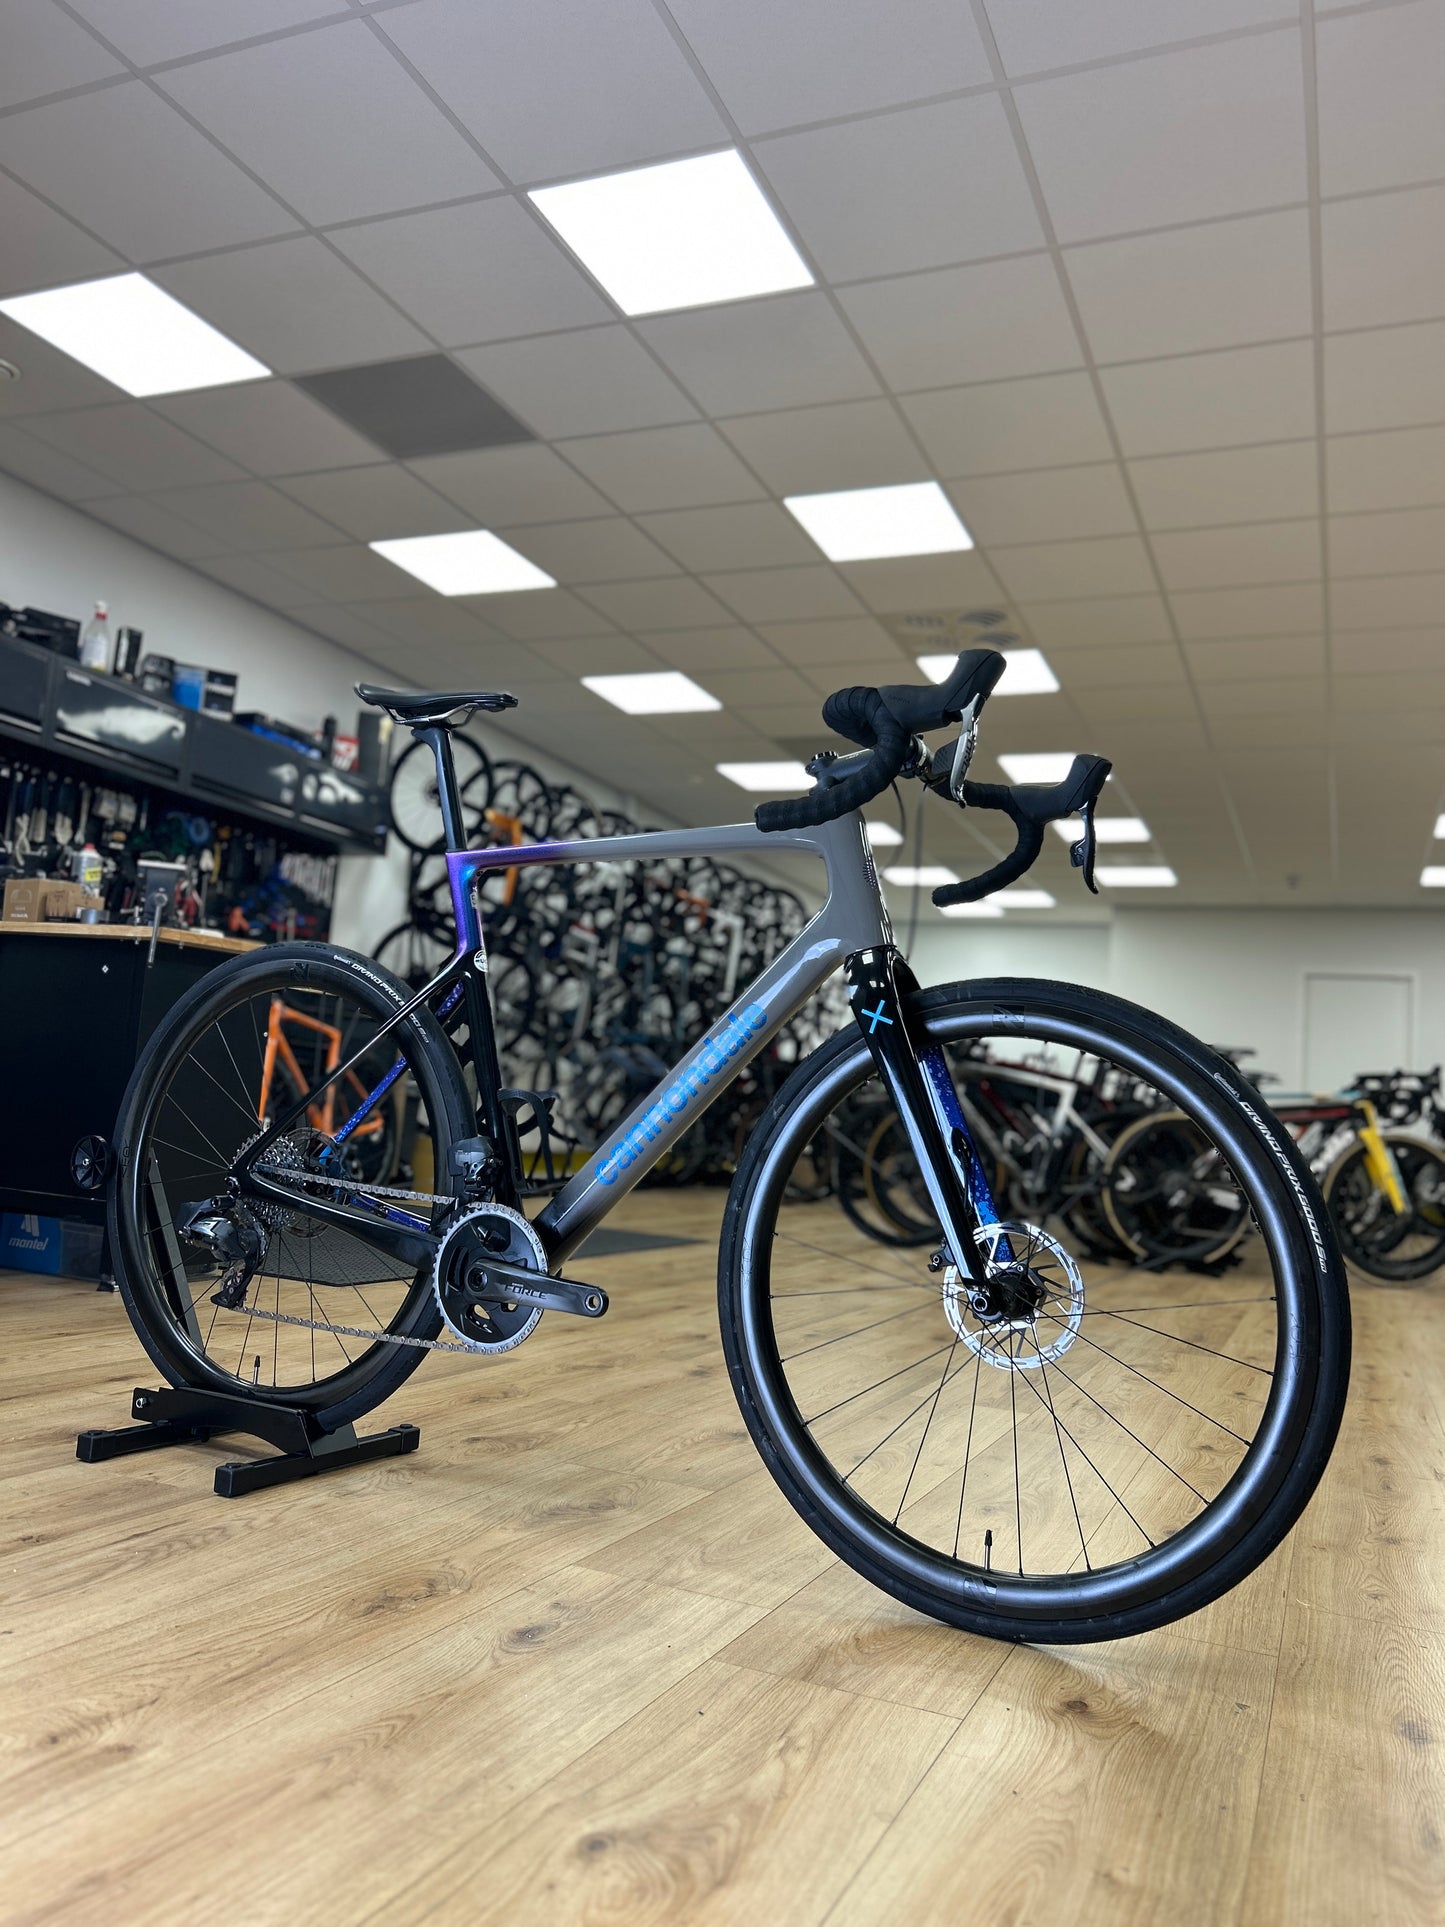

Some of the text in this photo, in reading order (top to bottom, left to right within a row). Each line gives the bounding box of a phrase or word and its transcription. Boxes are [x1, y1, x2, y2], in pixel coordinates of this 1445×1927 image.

[351, 963, 382, 985] GRAND
[379, 980, 402, 1003] PRIX
[594, 1003, 768, 1186] cannondale
[1240, 1101, 1283, 1153] GRAND
[1275, 1151, 1305, 1194] PRIX
[8, 1236, 50, 1251] mantel
[504, 1284, 547, 1298] FORCE
